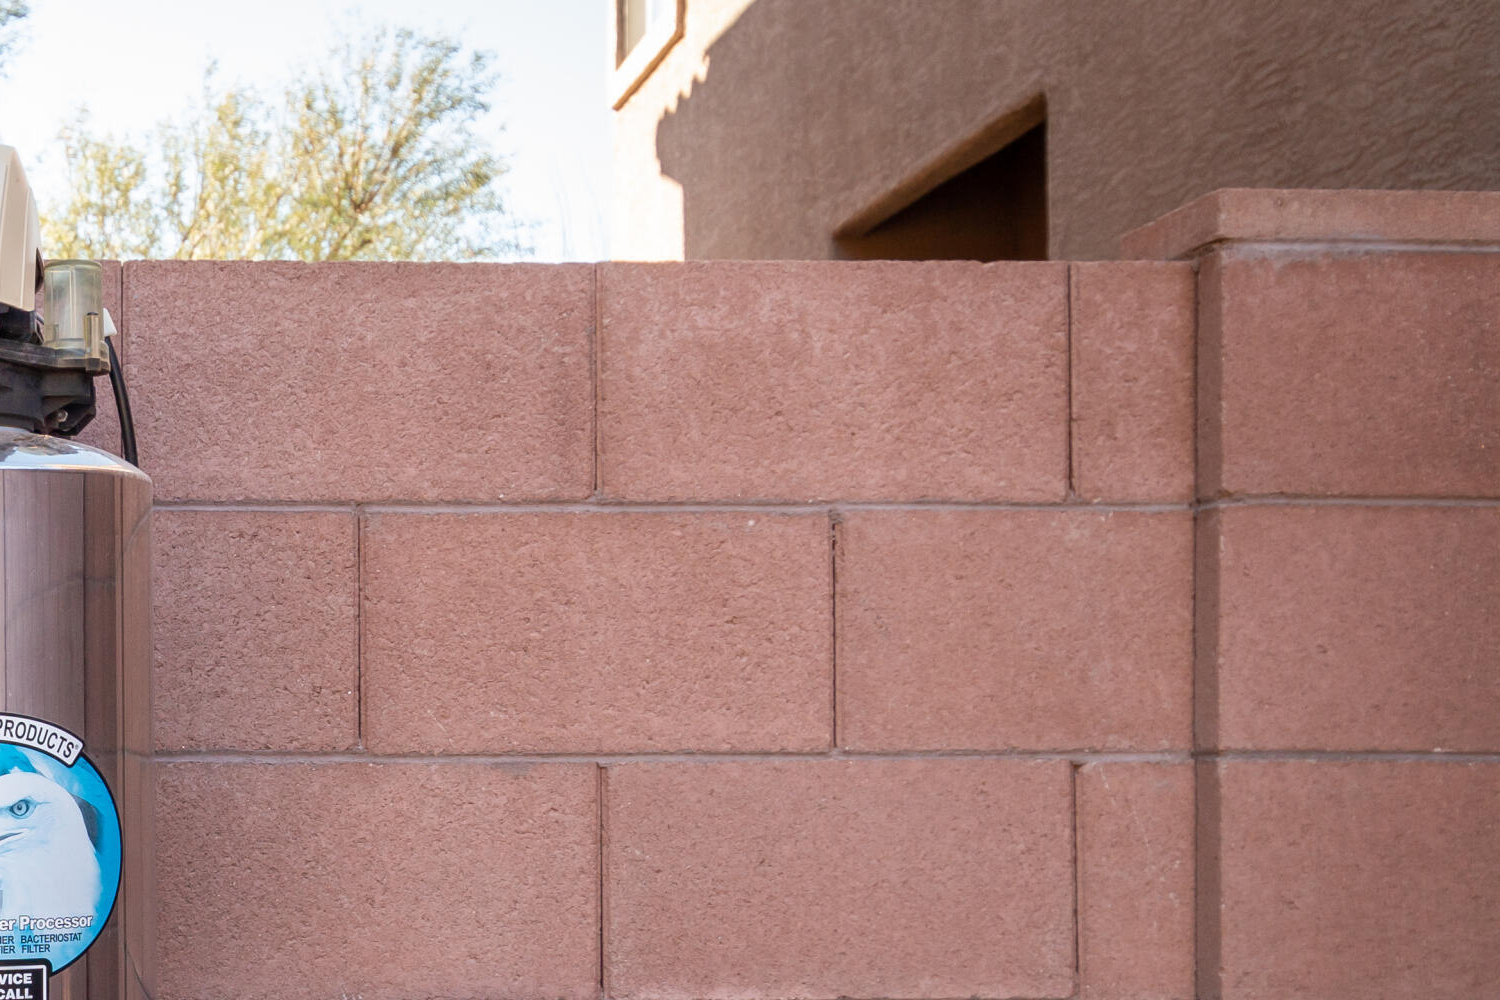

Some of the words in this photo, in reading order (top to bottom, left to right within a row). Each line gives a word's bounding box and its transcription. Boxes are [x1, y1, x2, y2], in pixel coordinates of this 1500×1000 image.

[19, 915, 93, 930] Processor
[20, 932, 82, 943] BACTERIOSTAT
[21, 944, 50, 953] FILTER
